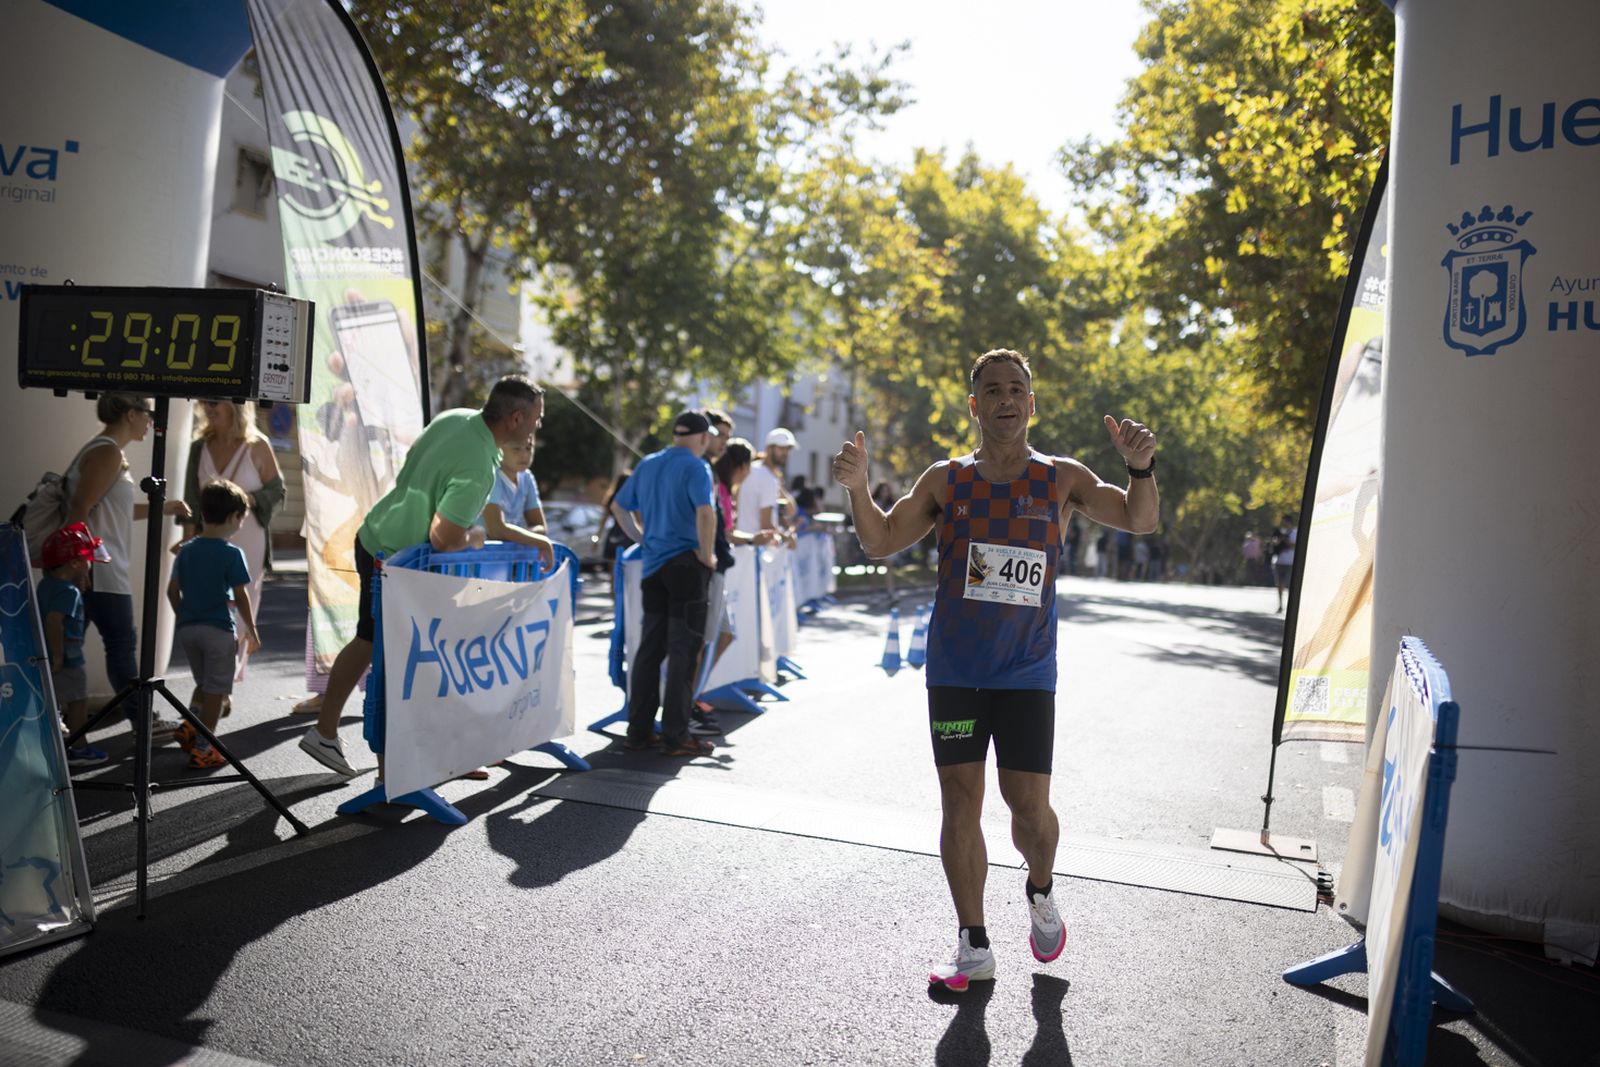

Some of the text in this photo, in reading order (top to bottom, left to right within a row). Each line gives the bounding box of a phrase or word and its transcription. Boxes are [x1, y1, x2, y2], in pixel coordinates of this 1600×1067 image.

[1450, 94, 1600, 166] Hue
[31, 265, 48, 278] de
[999, 558, 1042, 586] 406
